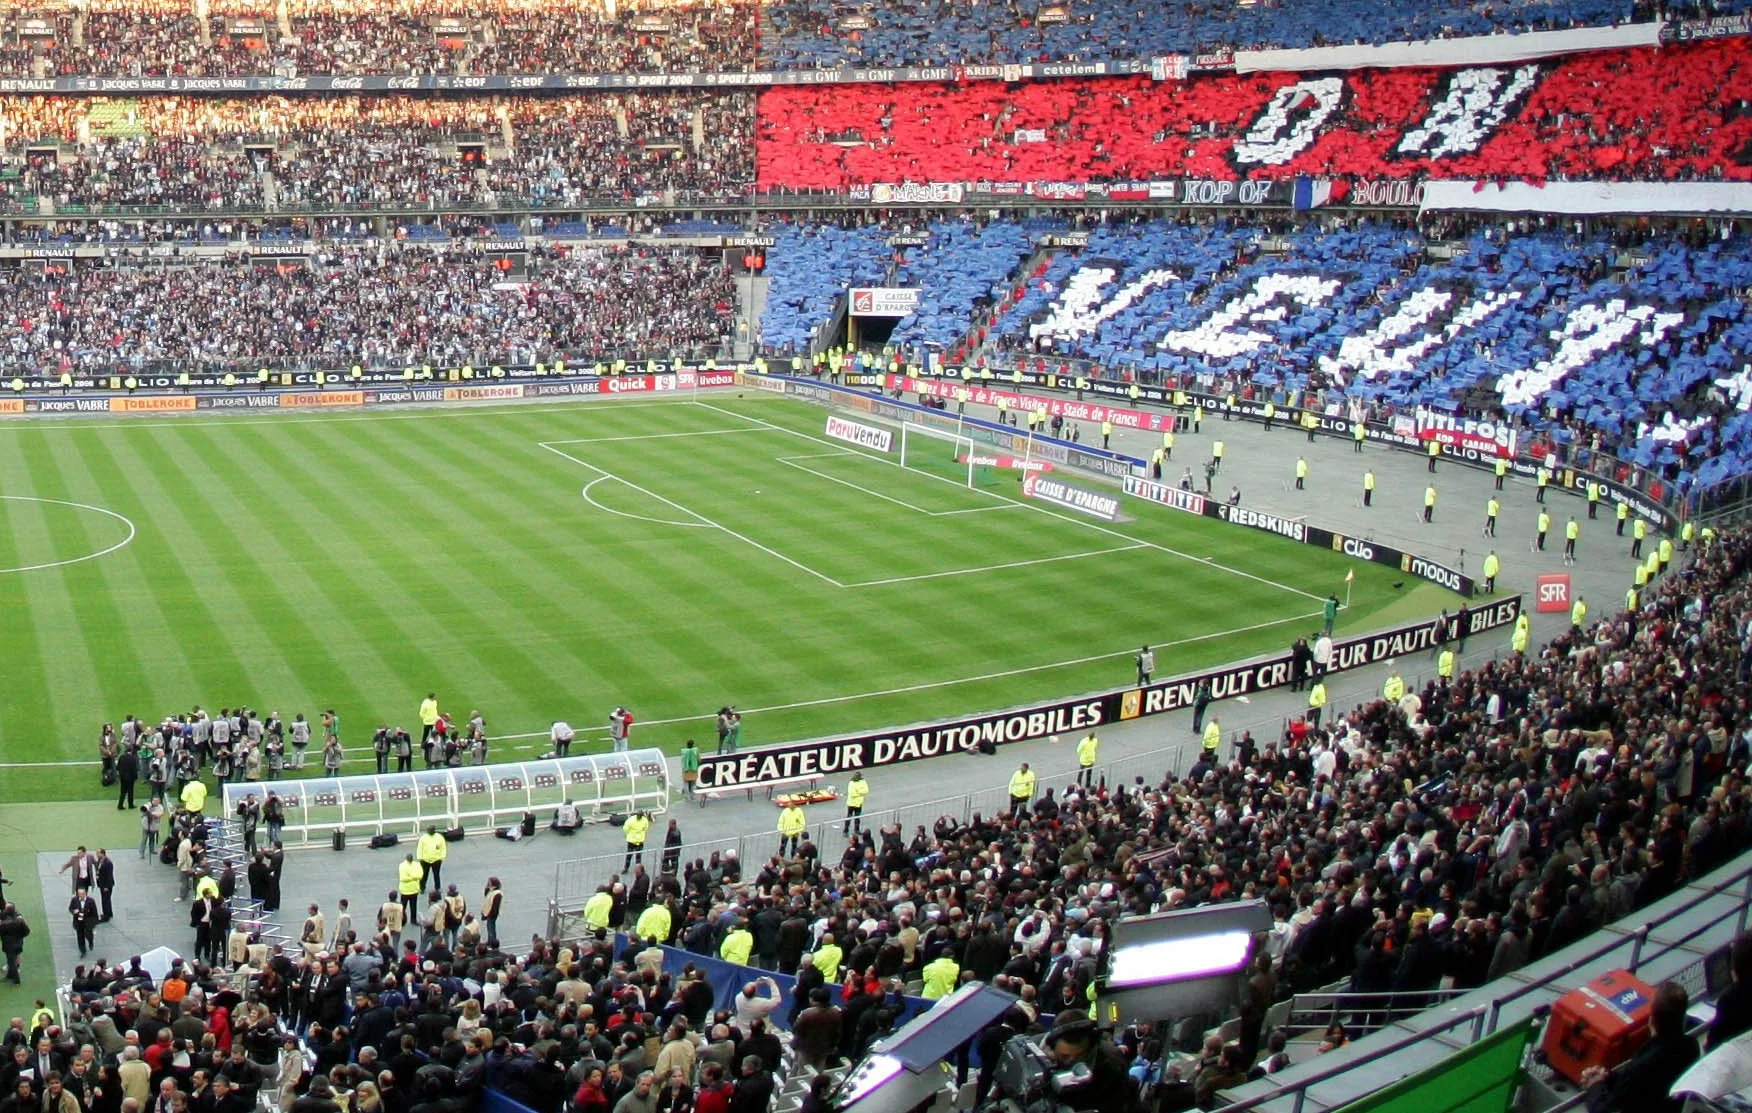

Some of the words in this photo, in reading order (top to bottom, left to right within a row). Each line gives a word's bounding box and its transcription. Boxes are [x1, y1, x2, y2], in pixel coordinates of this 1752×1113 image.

[922, 68, 948, 80] GMF
[1045, 63, 1097, 74] cetelem
[639, 75, 668, 85] SPORT
[669, 75, 694, 85] 2000
[718, 74, 747, 84] SPORT
[748, 74, 773, 84] 2000
[817, 71, 843, 82] GMF
[870, 70, 896, 81] GMF
[2, 80, 56, 91] RENAULT
[1183, 180, 1233, 204] KOP
[1241, 180, 1273, 204] OF
[1353, 180, 1425, 207] BOULO
[487, 241, 525, 250] RENAULT
[734, 237, 775, 246] RENAULT
[33, 248, 75, 257] RENAULT
[261, 245, 302, 254] RENAULT
[624, 364, 666, 373] CLO
[295, 374, 339, 384] CLO
[609, 378, 647, 392] Quick
[679, 374, 695, 385] SFR
[699, 374, 734, 386] livebox
[1058, 378, 1092, 391] CLO
[458, 387, 520, 399] TOBLERONE
[572, 383, 601, 394] VABRE
[939, 383, 948, 395] le
[976, 390, 987, 402] de
[249, 396, 280, 407] VABRE
[295, 393, 358, 407] TOBLERONE
[414, 390, 445, 401] VABRE
[78, 399, 110, 411] VABRE
[125, 398, 192, 410] TOBLERONE
[1185, 396, 1217, 409] CLIO
[1020, 396, 1049, 410] Visitez
[1052, 402, 1062, 415] le
[1064, 404, 1090, 420] Stade
[1093, 408, 1104, 421] de
[1108, 410, 1139, 428] France
[827, 418, 890, 450] ParuVendu
[1416, 404, 1518, 457] TITI-FOSI
[1437, 431, 1455, 444] KOP
[1443, 445, 1478, 460] CLIO
[1105, 459, 1131, 477] VABRE
[1575, 476, 1609, 496] CLO
[1035, 478, 1065, 499] CAISSE
[1066, 485, 1119, 515] D'EPARGNE
[1230, 506, 1304, 541] REDSKINS
[1541, 582, 1568, 603] SFR
[695, 742, 863, 788] CRÉATEUR
[873, 700, 1103, 766] D'AUTOMOBILES
[1146, 668, 1254, 713] RENULT
[1257, 641, 1367, 688] CRAEUR
[1374, 595, 1517, 657] D'AUTOMBILES
